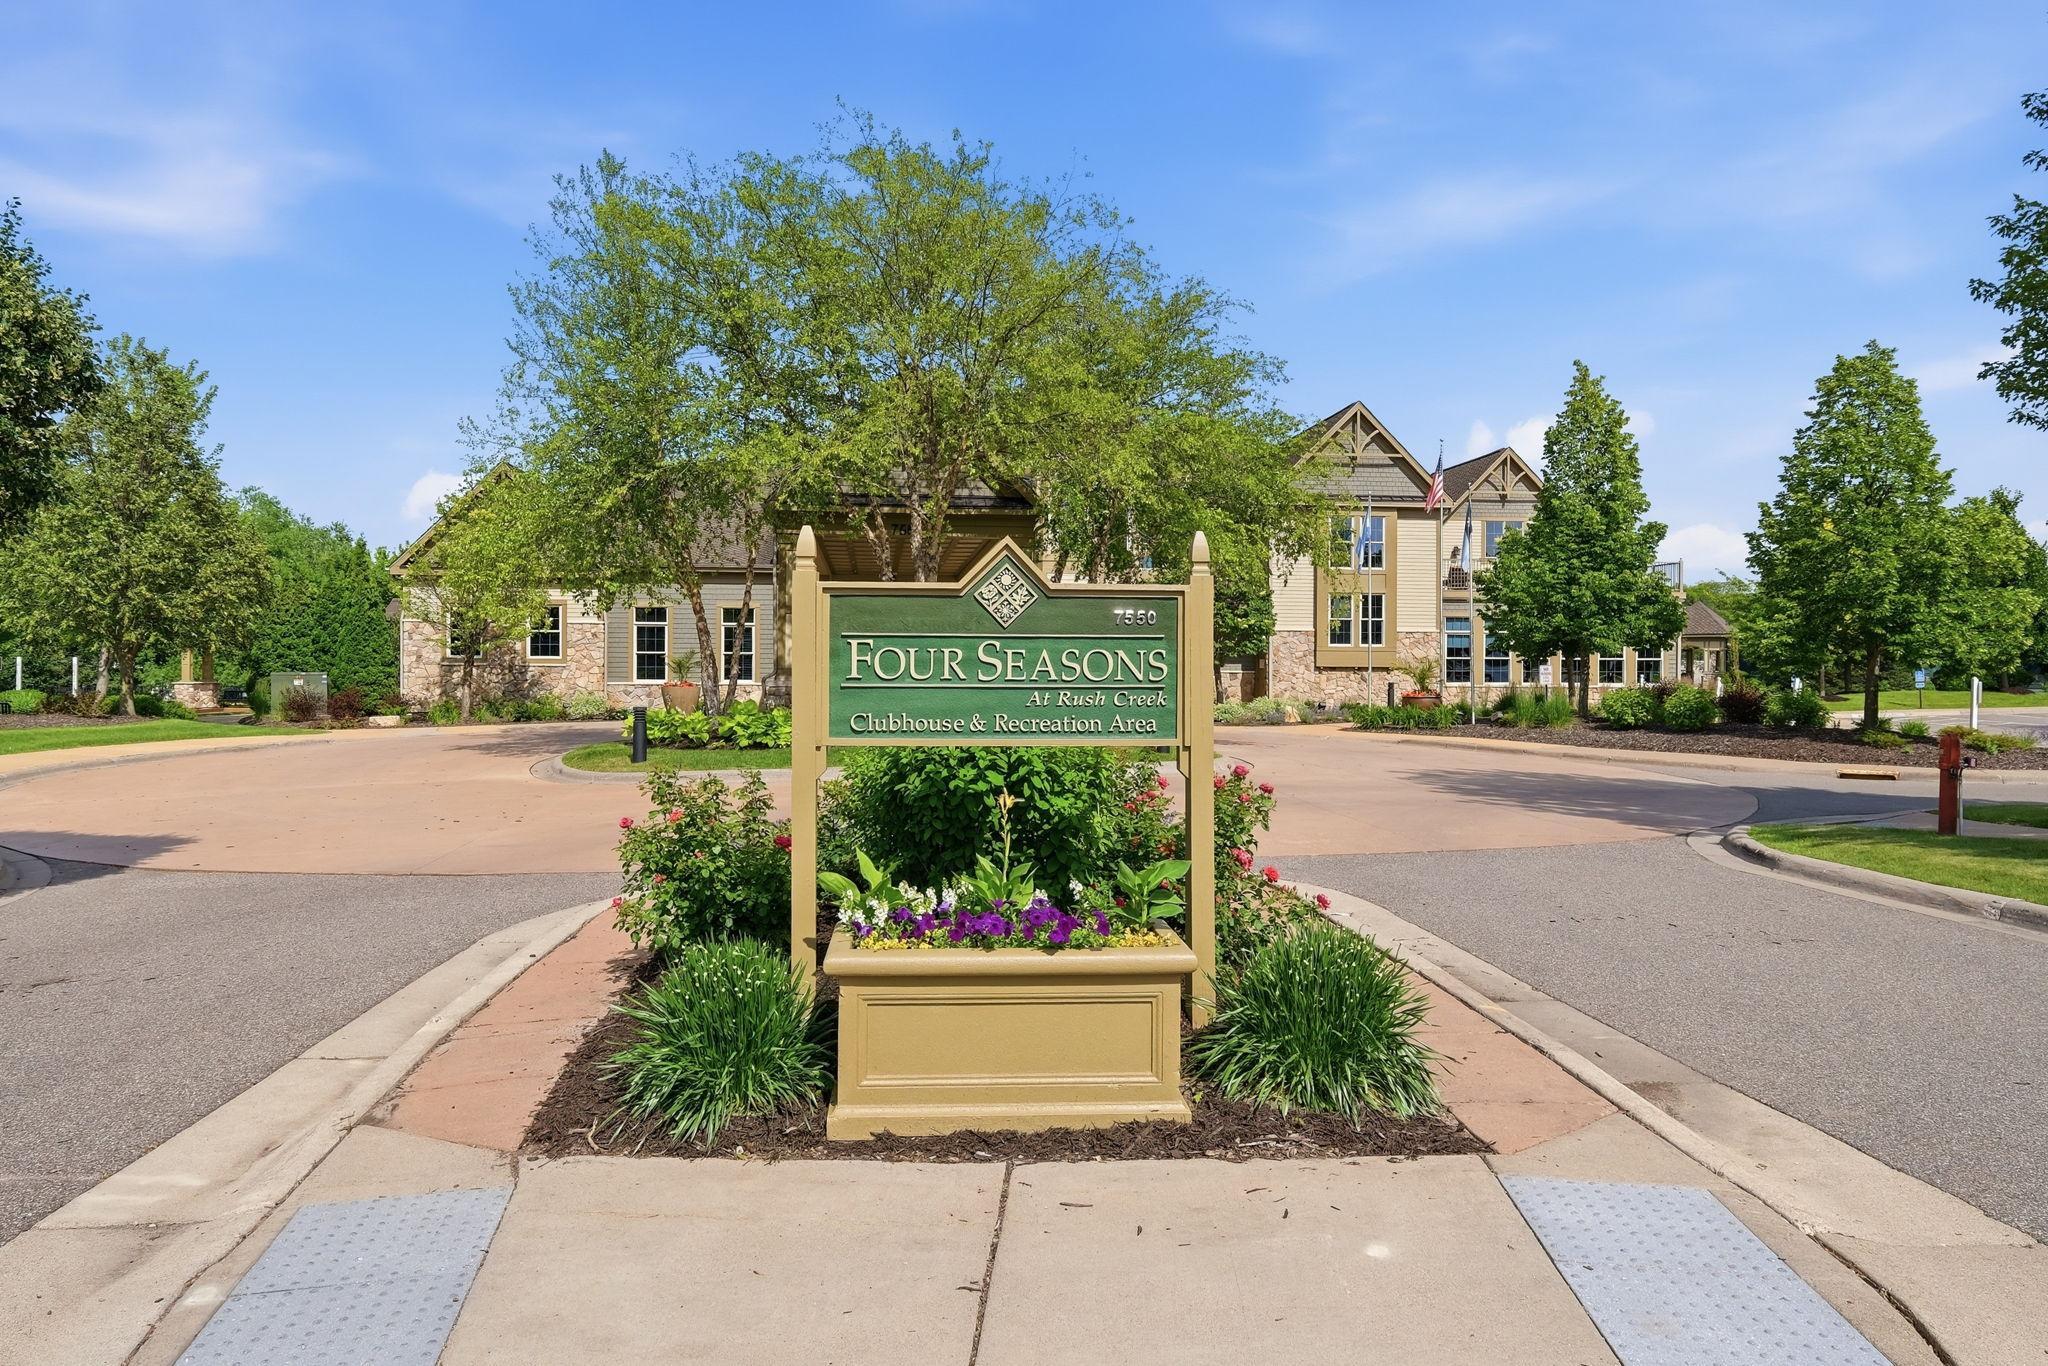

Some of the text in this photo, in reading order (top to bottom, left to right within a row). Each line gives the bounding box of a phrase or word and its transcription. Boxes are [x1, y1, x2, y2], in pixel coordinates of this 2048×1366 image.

[1113, 609, 1157, 625] 7550
[846, 639, 1168, 682] FOUR SEASONS
[1026, 691, 1168, 707] At Rush Creek
[850, 712, 1157, 733] Clubhouse & Recreation Area
